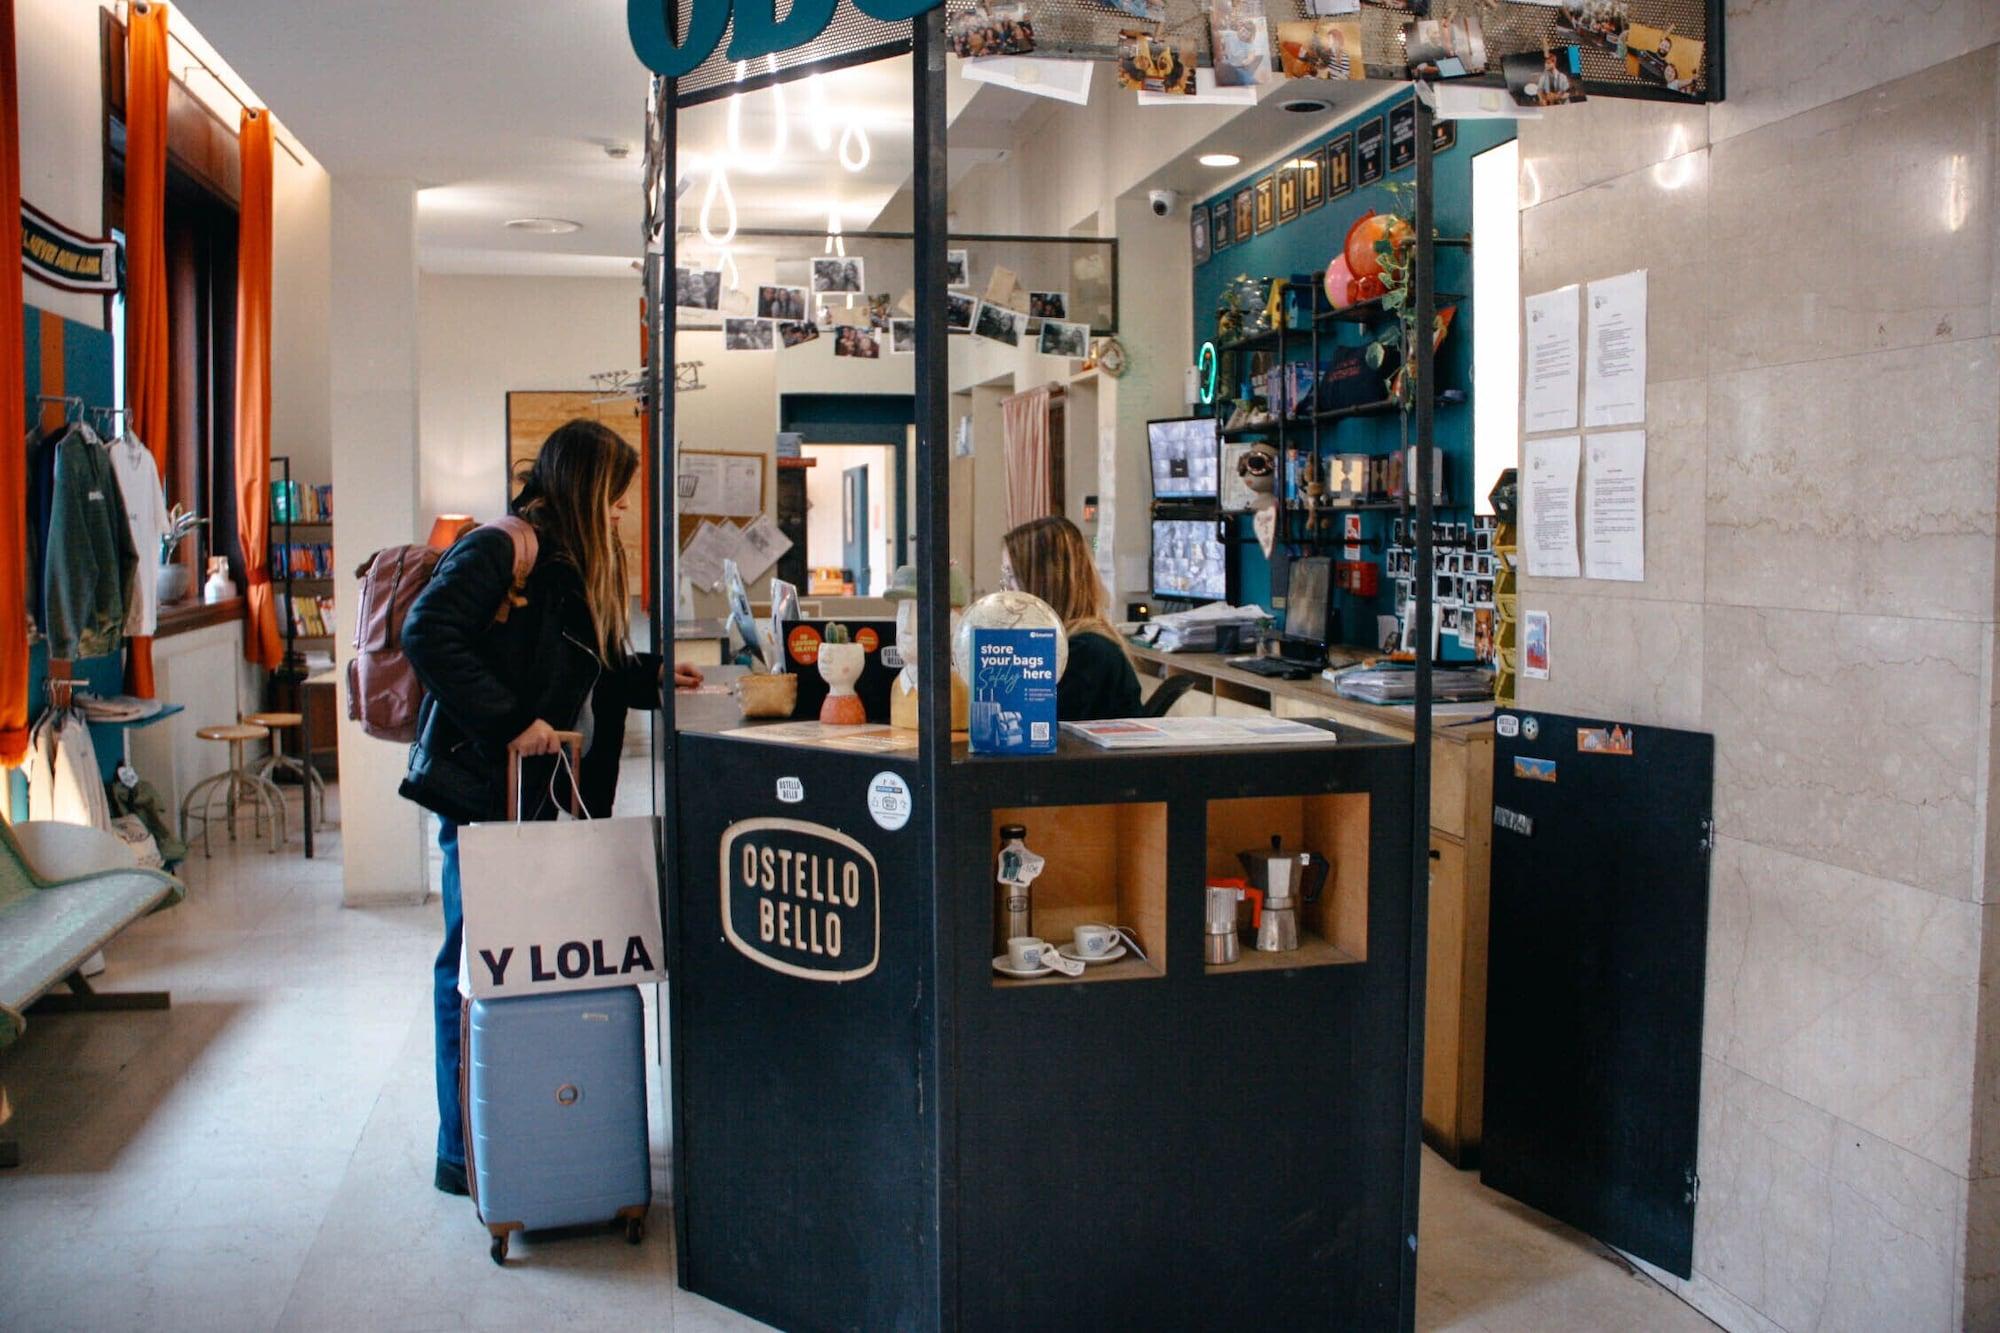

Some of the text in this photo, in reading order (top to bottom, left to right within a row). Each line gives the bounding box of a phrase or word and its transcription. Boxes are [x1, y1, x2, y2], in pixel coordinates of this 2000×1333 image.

[981, 644, 1014, 654] store
[981, 655, 1044, 668] your bags
[1023, 668, 1052, 679] here
[743, 843, 859, 908] OSTELLO
[760, 897, 841, 957] BELLO
[479, 936, 655, 986] Y LOLA
